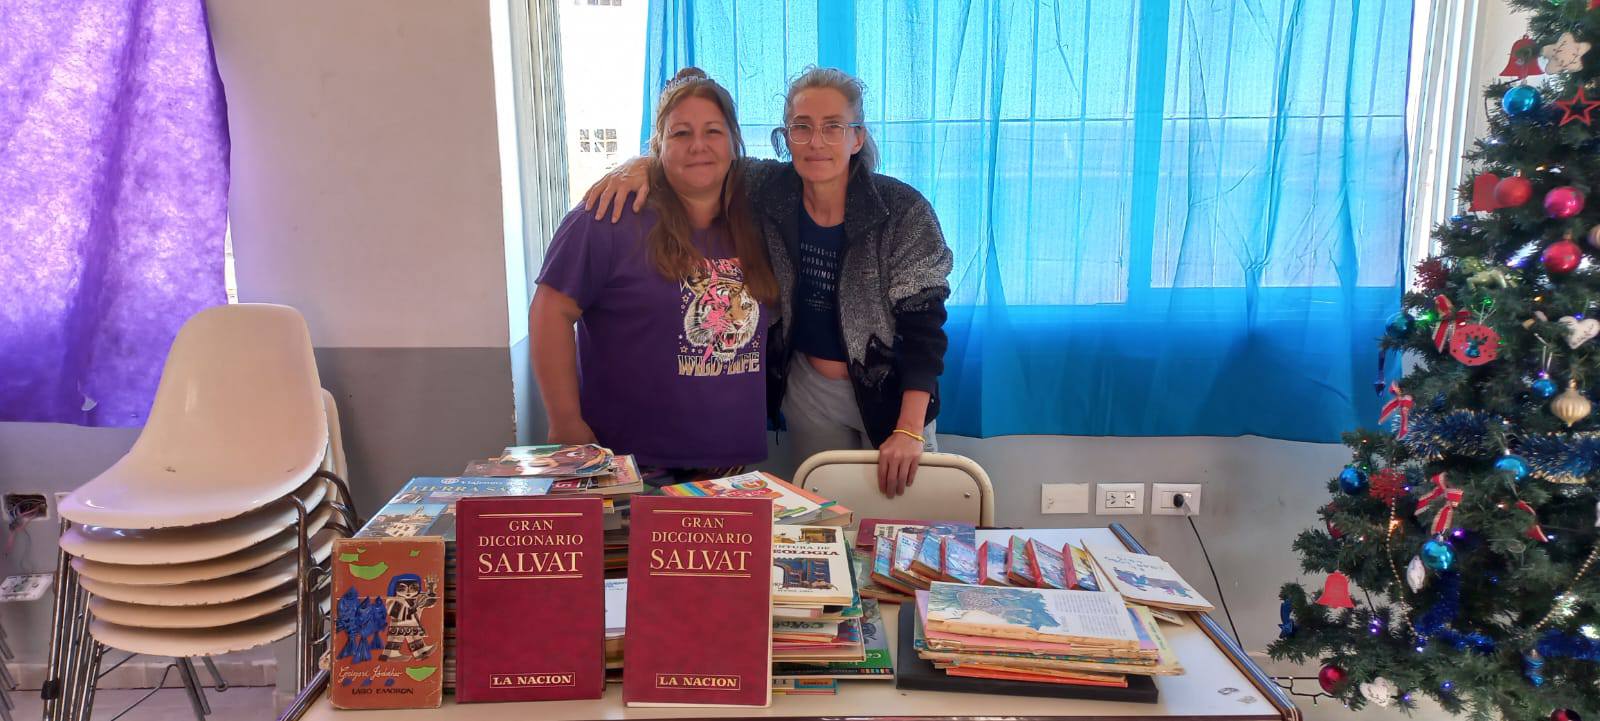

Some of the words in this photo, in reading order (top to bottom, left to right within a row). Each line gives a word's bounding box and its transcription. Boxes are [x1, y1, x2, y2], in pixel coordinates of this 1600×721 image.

[677, 354, 723, 377] WILD
[508, 519, 554, 532] GRAN
[681, 516, 724, 529] GRAN
[478, 534, 584, 548] DICCIONARIO
[651, 531, 753, 545] DICCIONARIO
[478, 551, 584, 574] SALVAT
[650, 548, 753, 572] SALVAT
[492, 676, 513, 686] LA
[517, 674, 573, 686] NACION
[659, 675, 678, 686] LA
[682, 676, 738, 687] NACION
